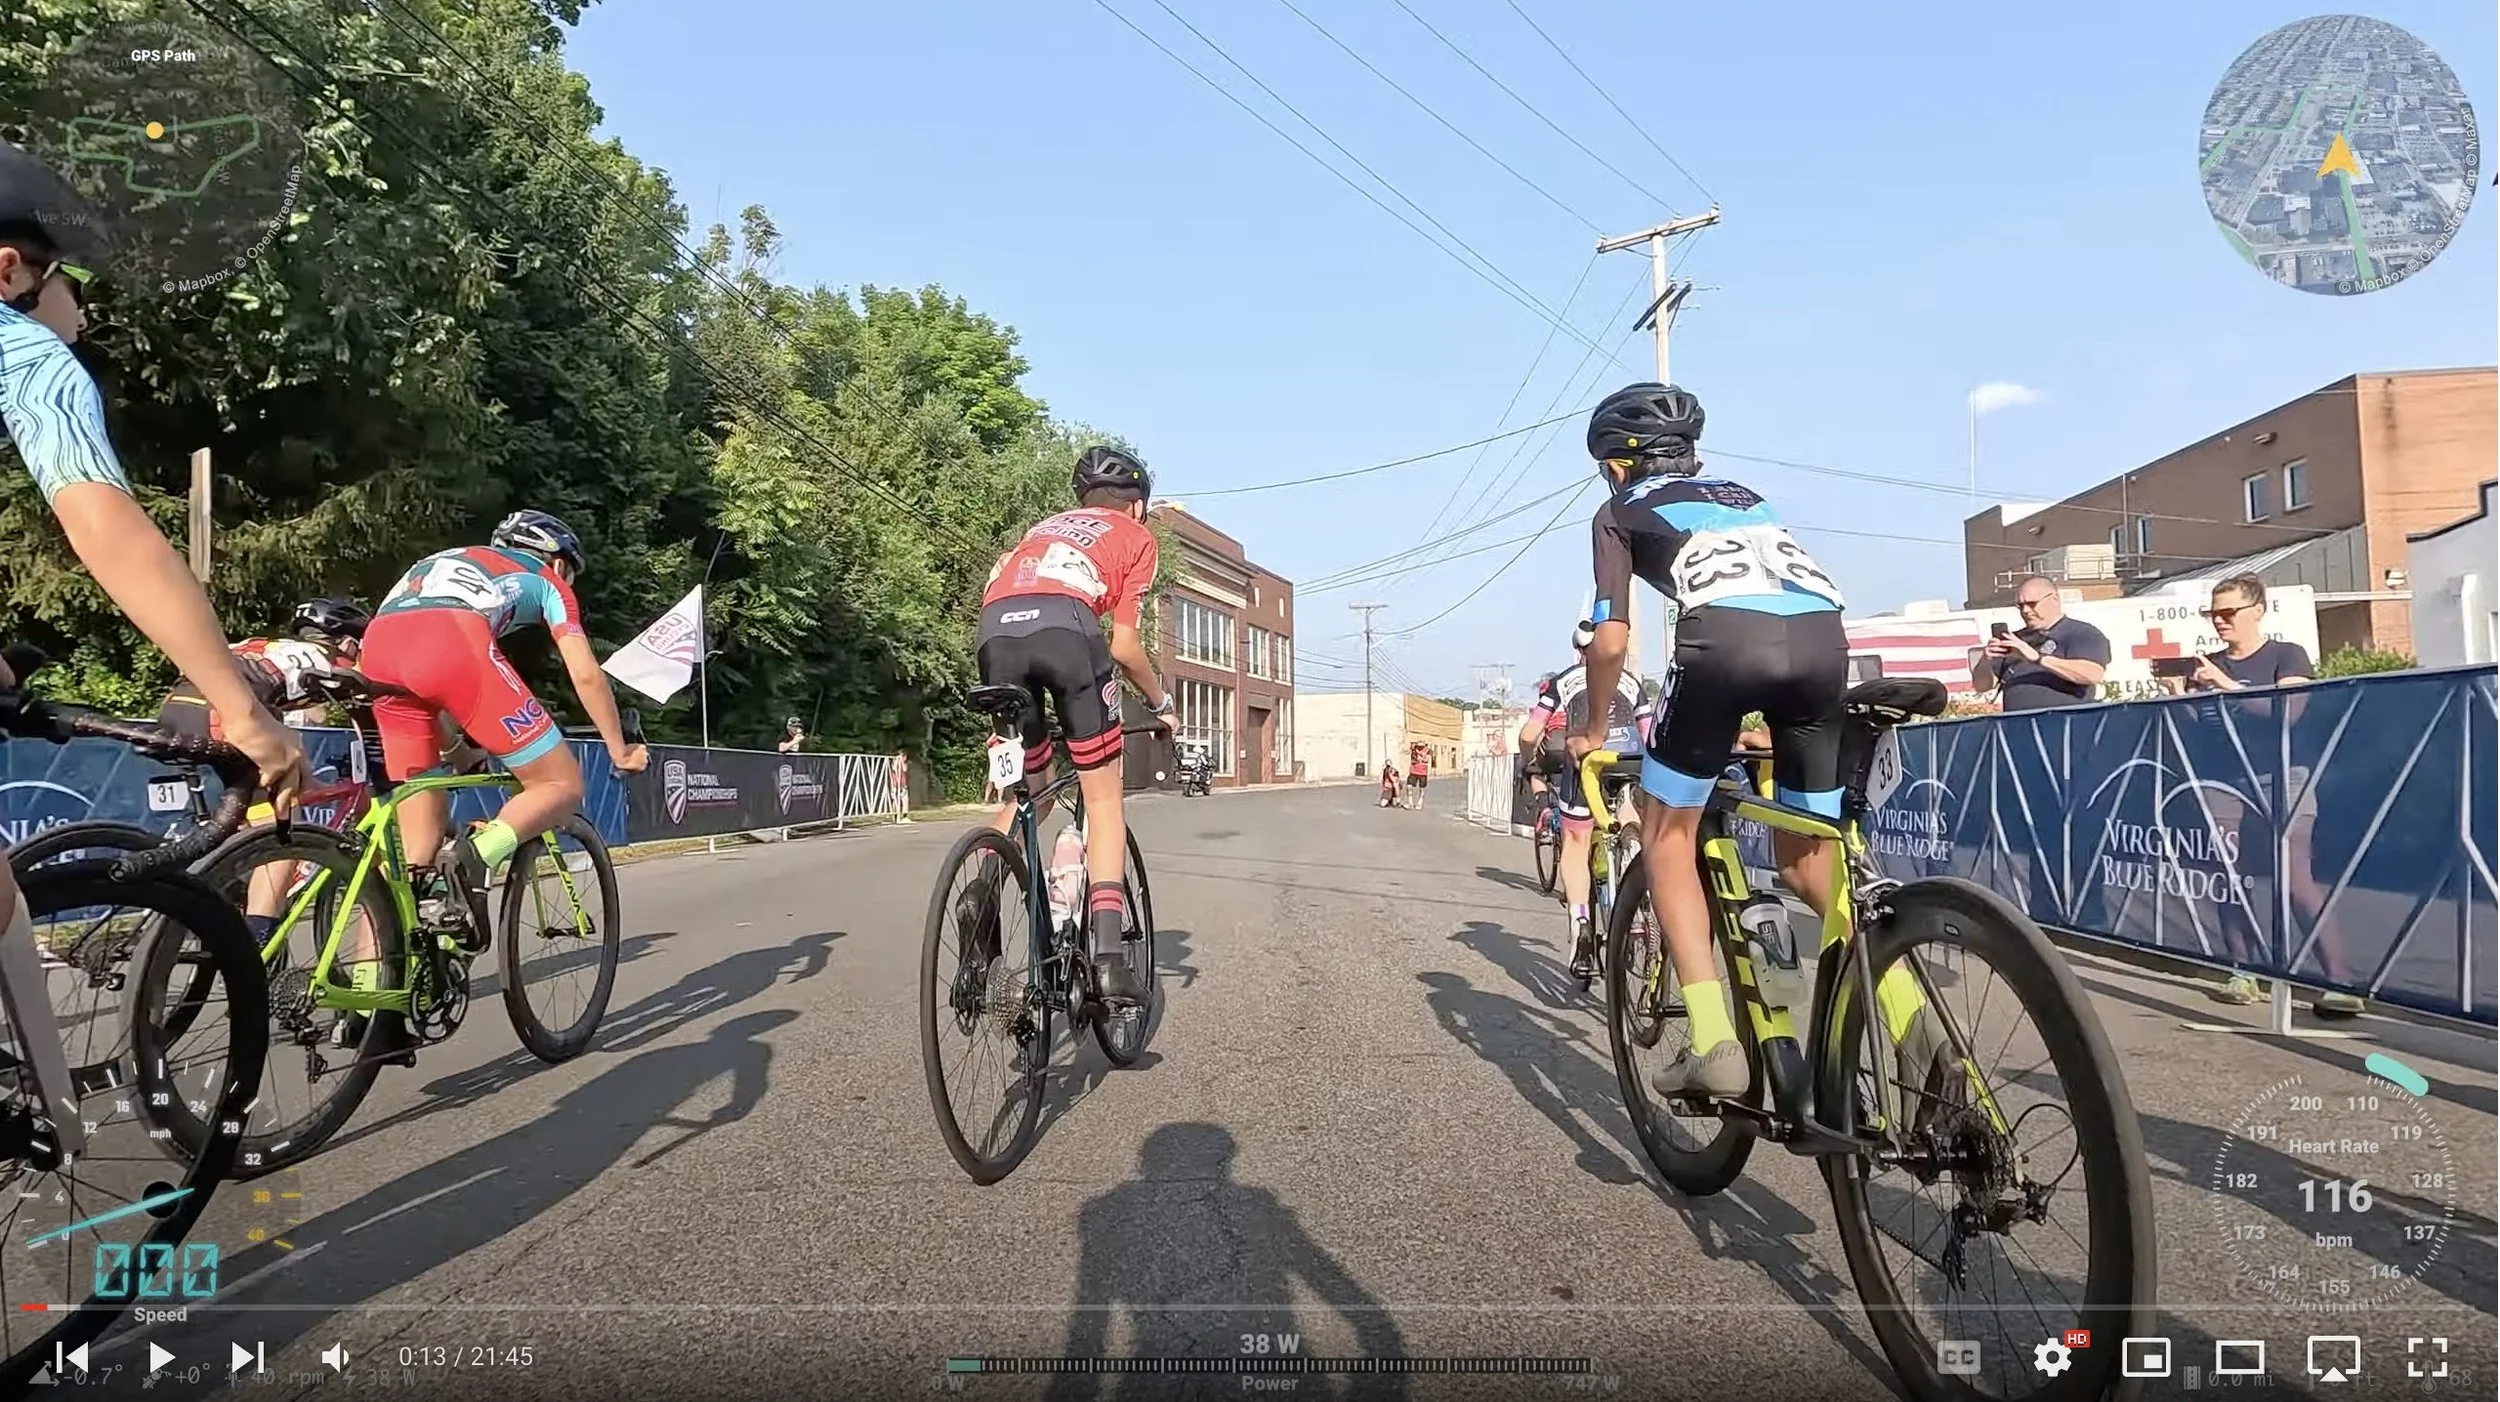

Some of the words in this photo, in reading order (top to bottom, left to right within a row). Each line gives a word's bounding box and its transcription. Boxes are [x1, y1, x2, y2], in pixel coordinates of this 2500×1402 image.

[448, 566, 492, 596] 40
[1684, 540, 1750, 593] 33
[997, 752, 1013, 778] 35
[1879, 748, 1893, 790] 33
[158, 785, 175, 803] 31
[1871, 830, 1903, 856] BLUE
[2101, 854, 2155, 893] BLUE
